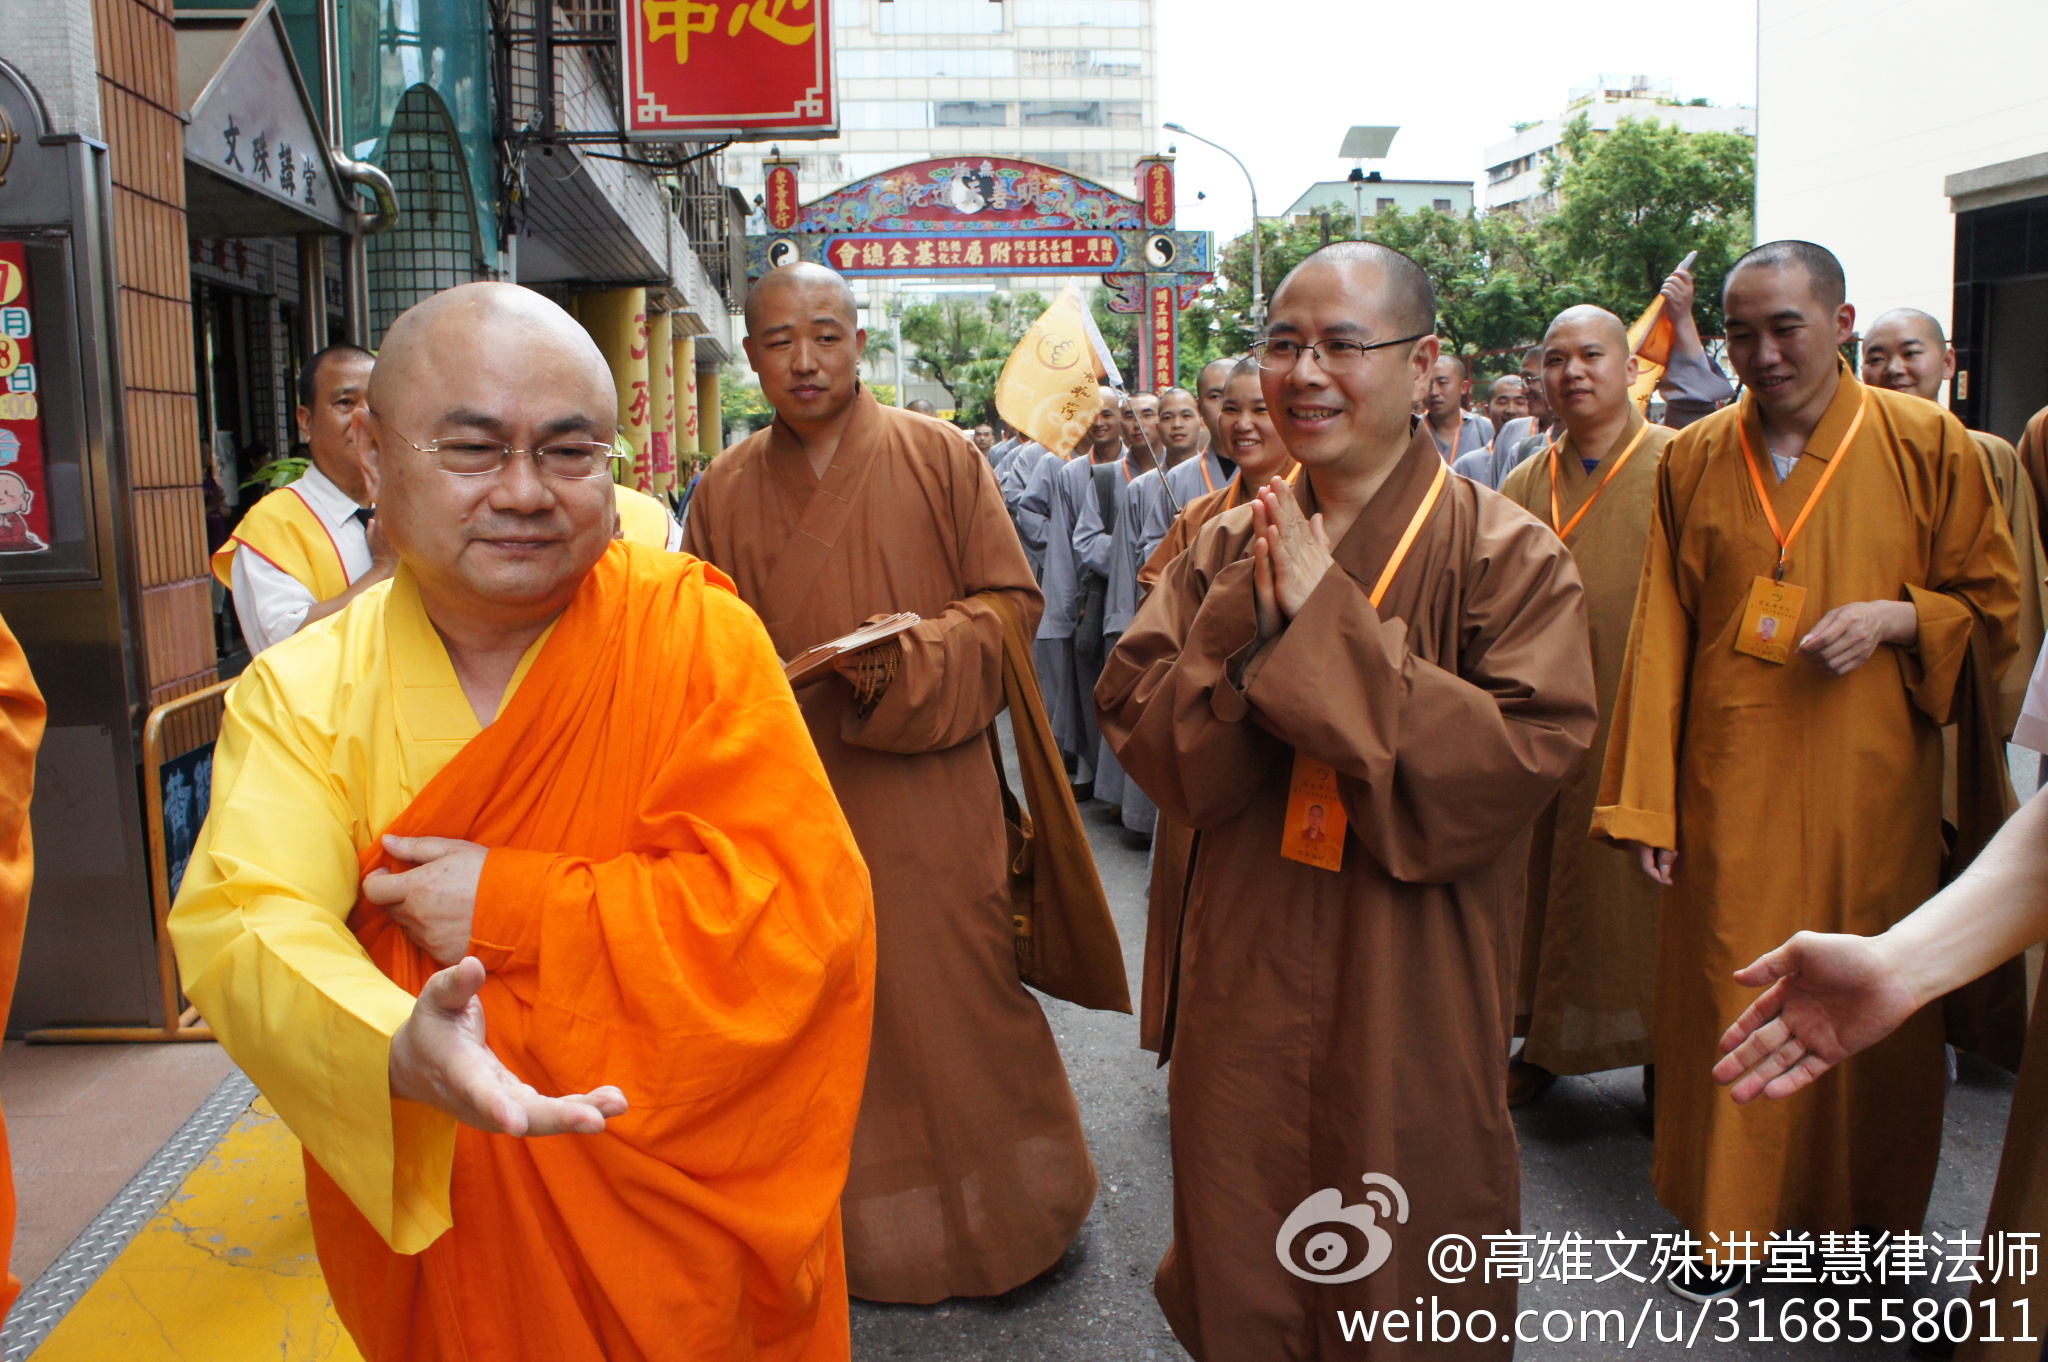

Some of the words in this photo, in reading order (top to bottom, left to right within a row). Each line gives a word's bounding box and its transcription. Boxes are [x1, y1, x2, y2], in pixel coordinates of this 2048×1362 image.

[643, 0, 815, 64] 中心
[223, 113, 317, 206] 文殊講堂
[3, 310, 26, 336] 月
